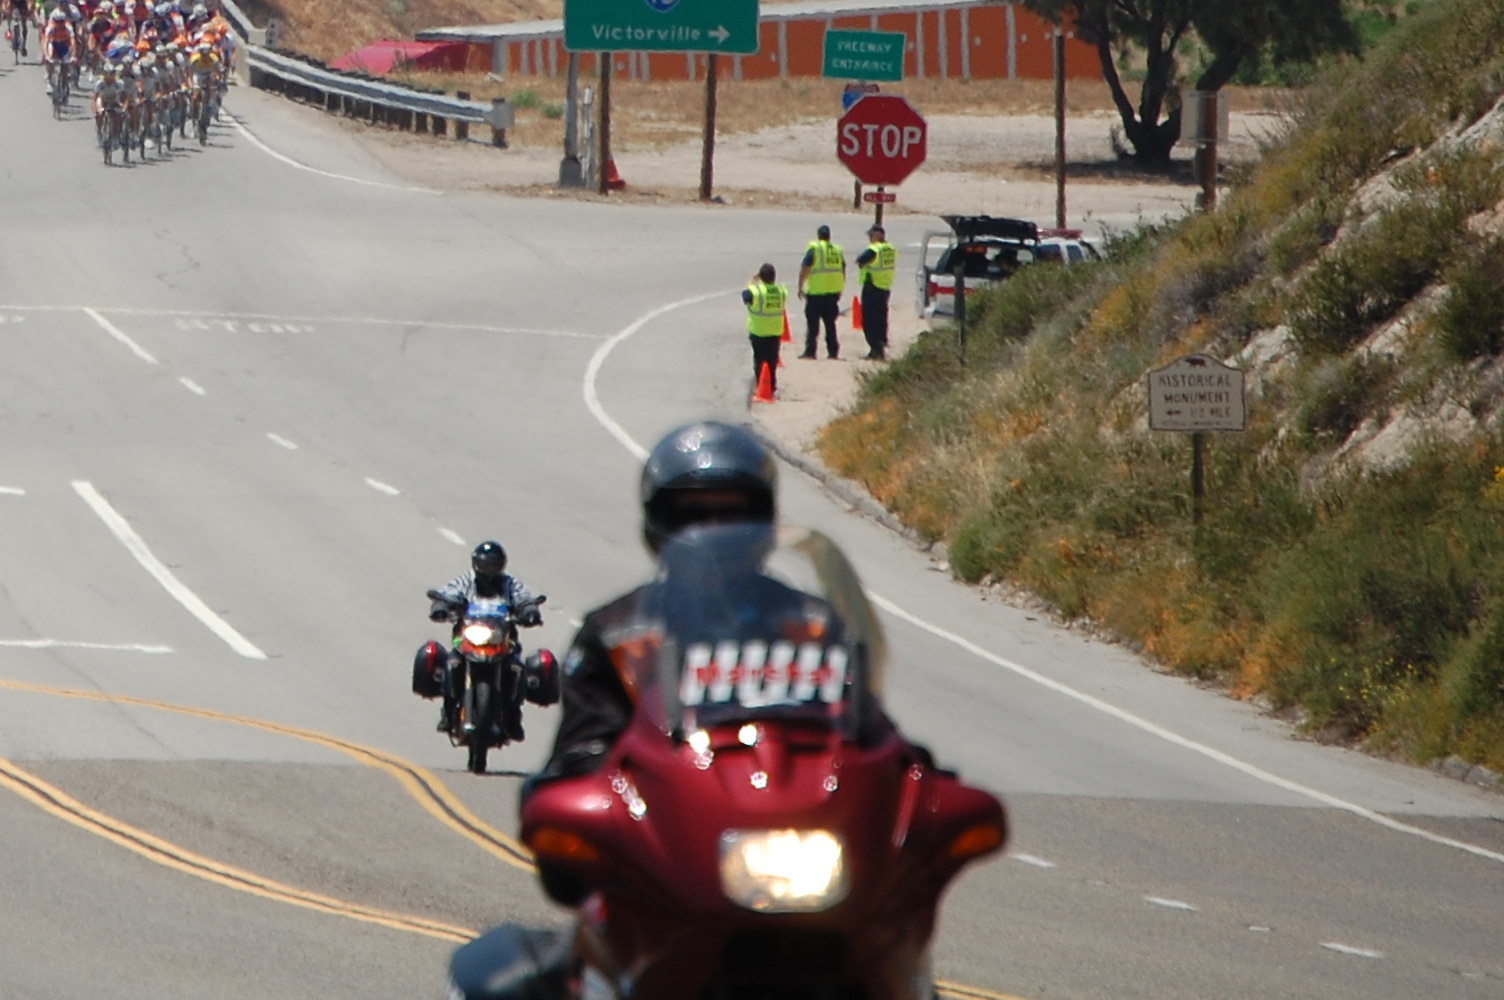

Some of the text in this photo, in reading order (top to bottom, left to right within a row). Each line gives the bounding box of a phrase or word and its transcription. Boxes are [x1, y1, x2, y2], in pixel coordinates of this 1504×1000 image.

[591, 24, 701, 41] Victorville
[837, 40, 893, 54] FREEWAY
[832, 57, 895, 73] ENTRANCE
[841, 122, 923, 160] STOP
[1158, 374, 1232, 388] HISTORICAL
[1164, 391, 1231, 404] MONUMENT
